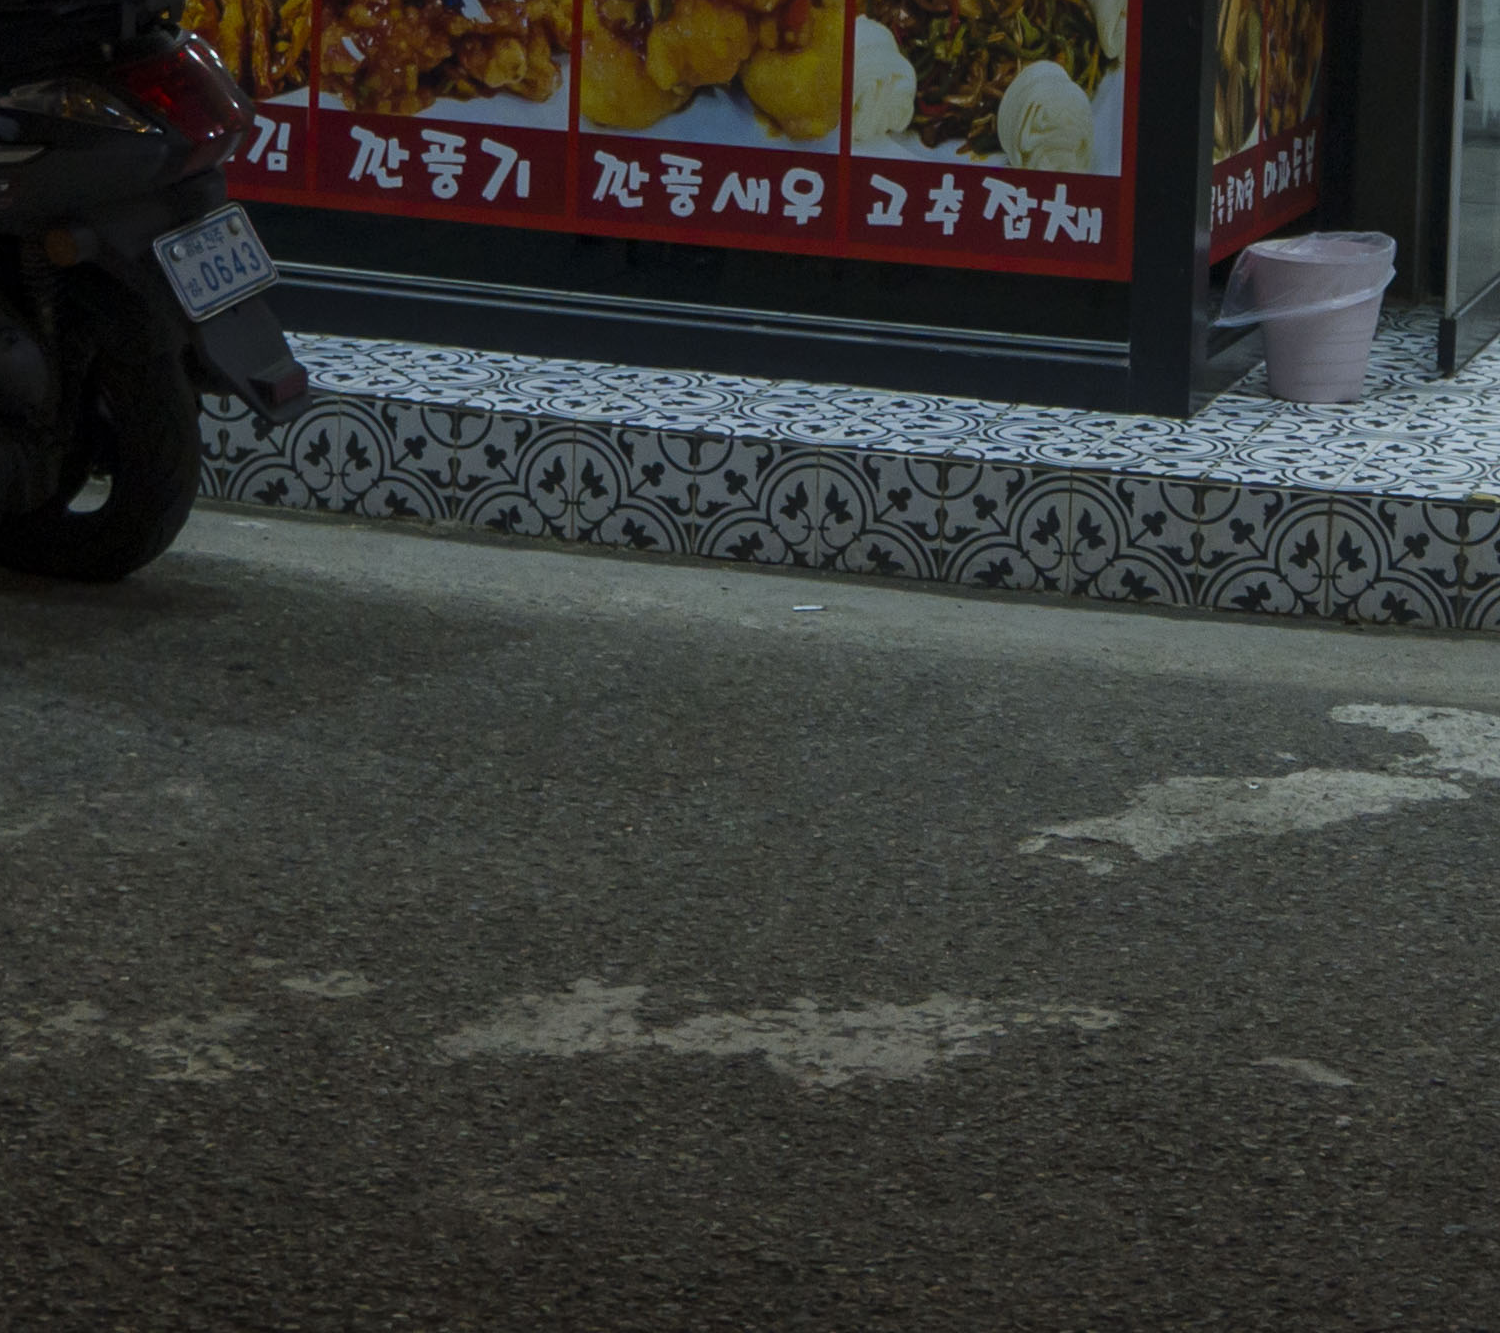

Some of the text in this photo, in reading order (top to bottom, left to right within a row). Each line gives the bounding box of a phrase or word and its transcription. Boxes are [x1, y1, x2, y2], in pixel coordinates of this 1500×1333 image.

[348, 122, 532, 201] 깐풍기
[592, 148, 826, 227] 깐풍새우
[865, 171, 1103, 245] 고추잡채
[200, 241, 261, 292] 0643
